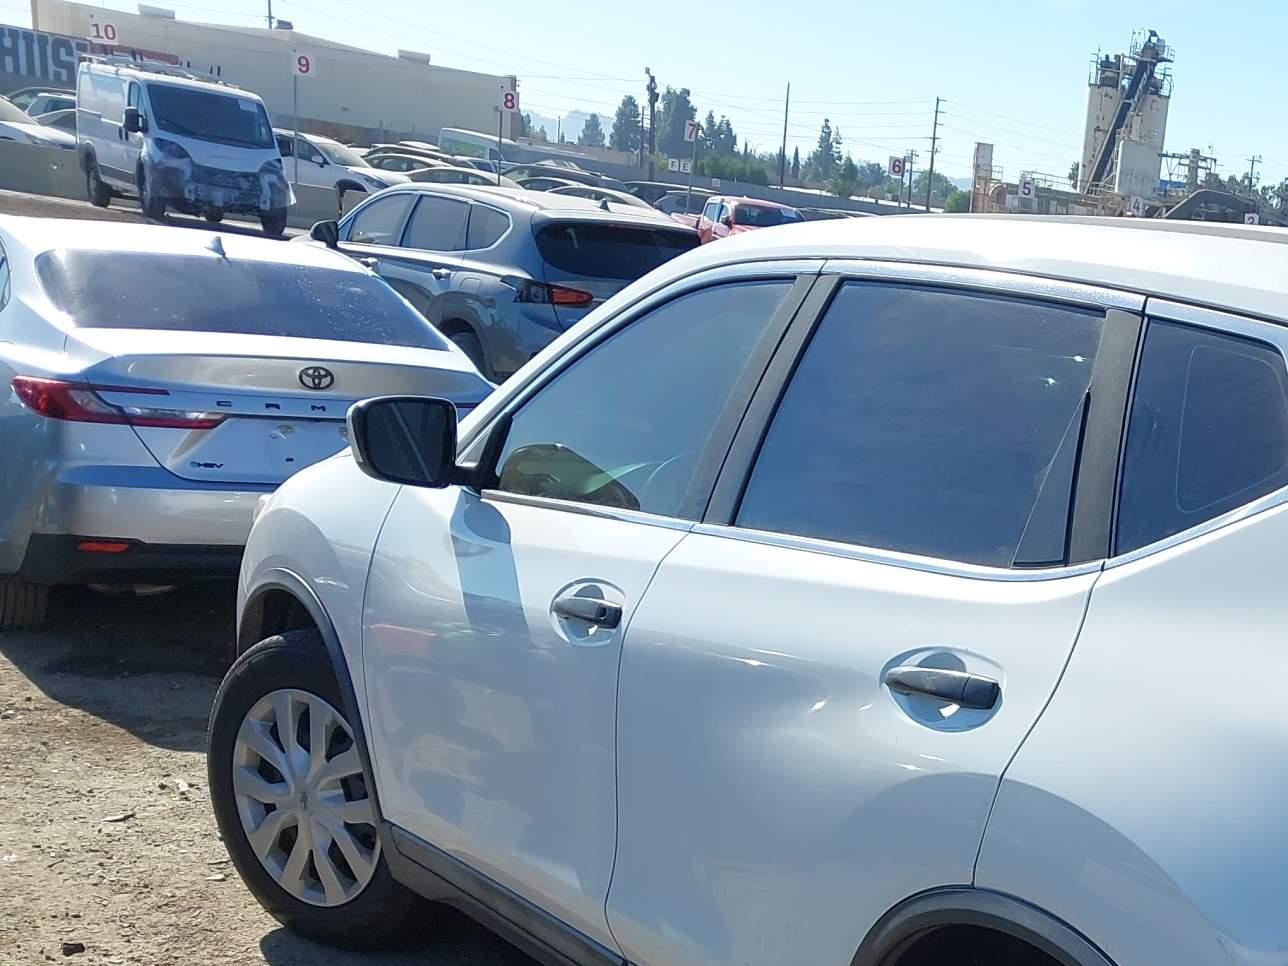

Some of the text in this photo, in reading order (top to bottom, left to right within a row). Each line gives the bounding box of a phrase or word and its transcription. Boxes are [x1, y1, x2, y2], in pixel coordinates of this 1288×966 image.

[91, 23, 116, 40] 10
[297, 55, 310, 74] 9
[503, 92, 516, 110] 8
[688, 122, 697, 140] 7
[891, 159, 902, 174] 6
[1021, 181, 1032, 196] 5
[1132, 198, 1140, 211] 4
